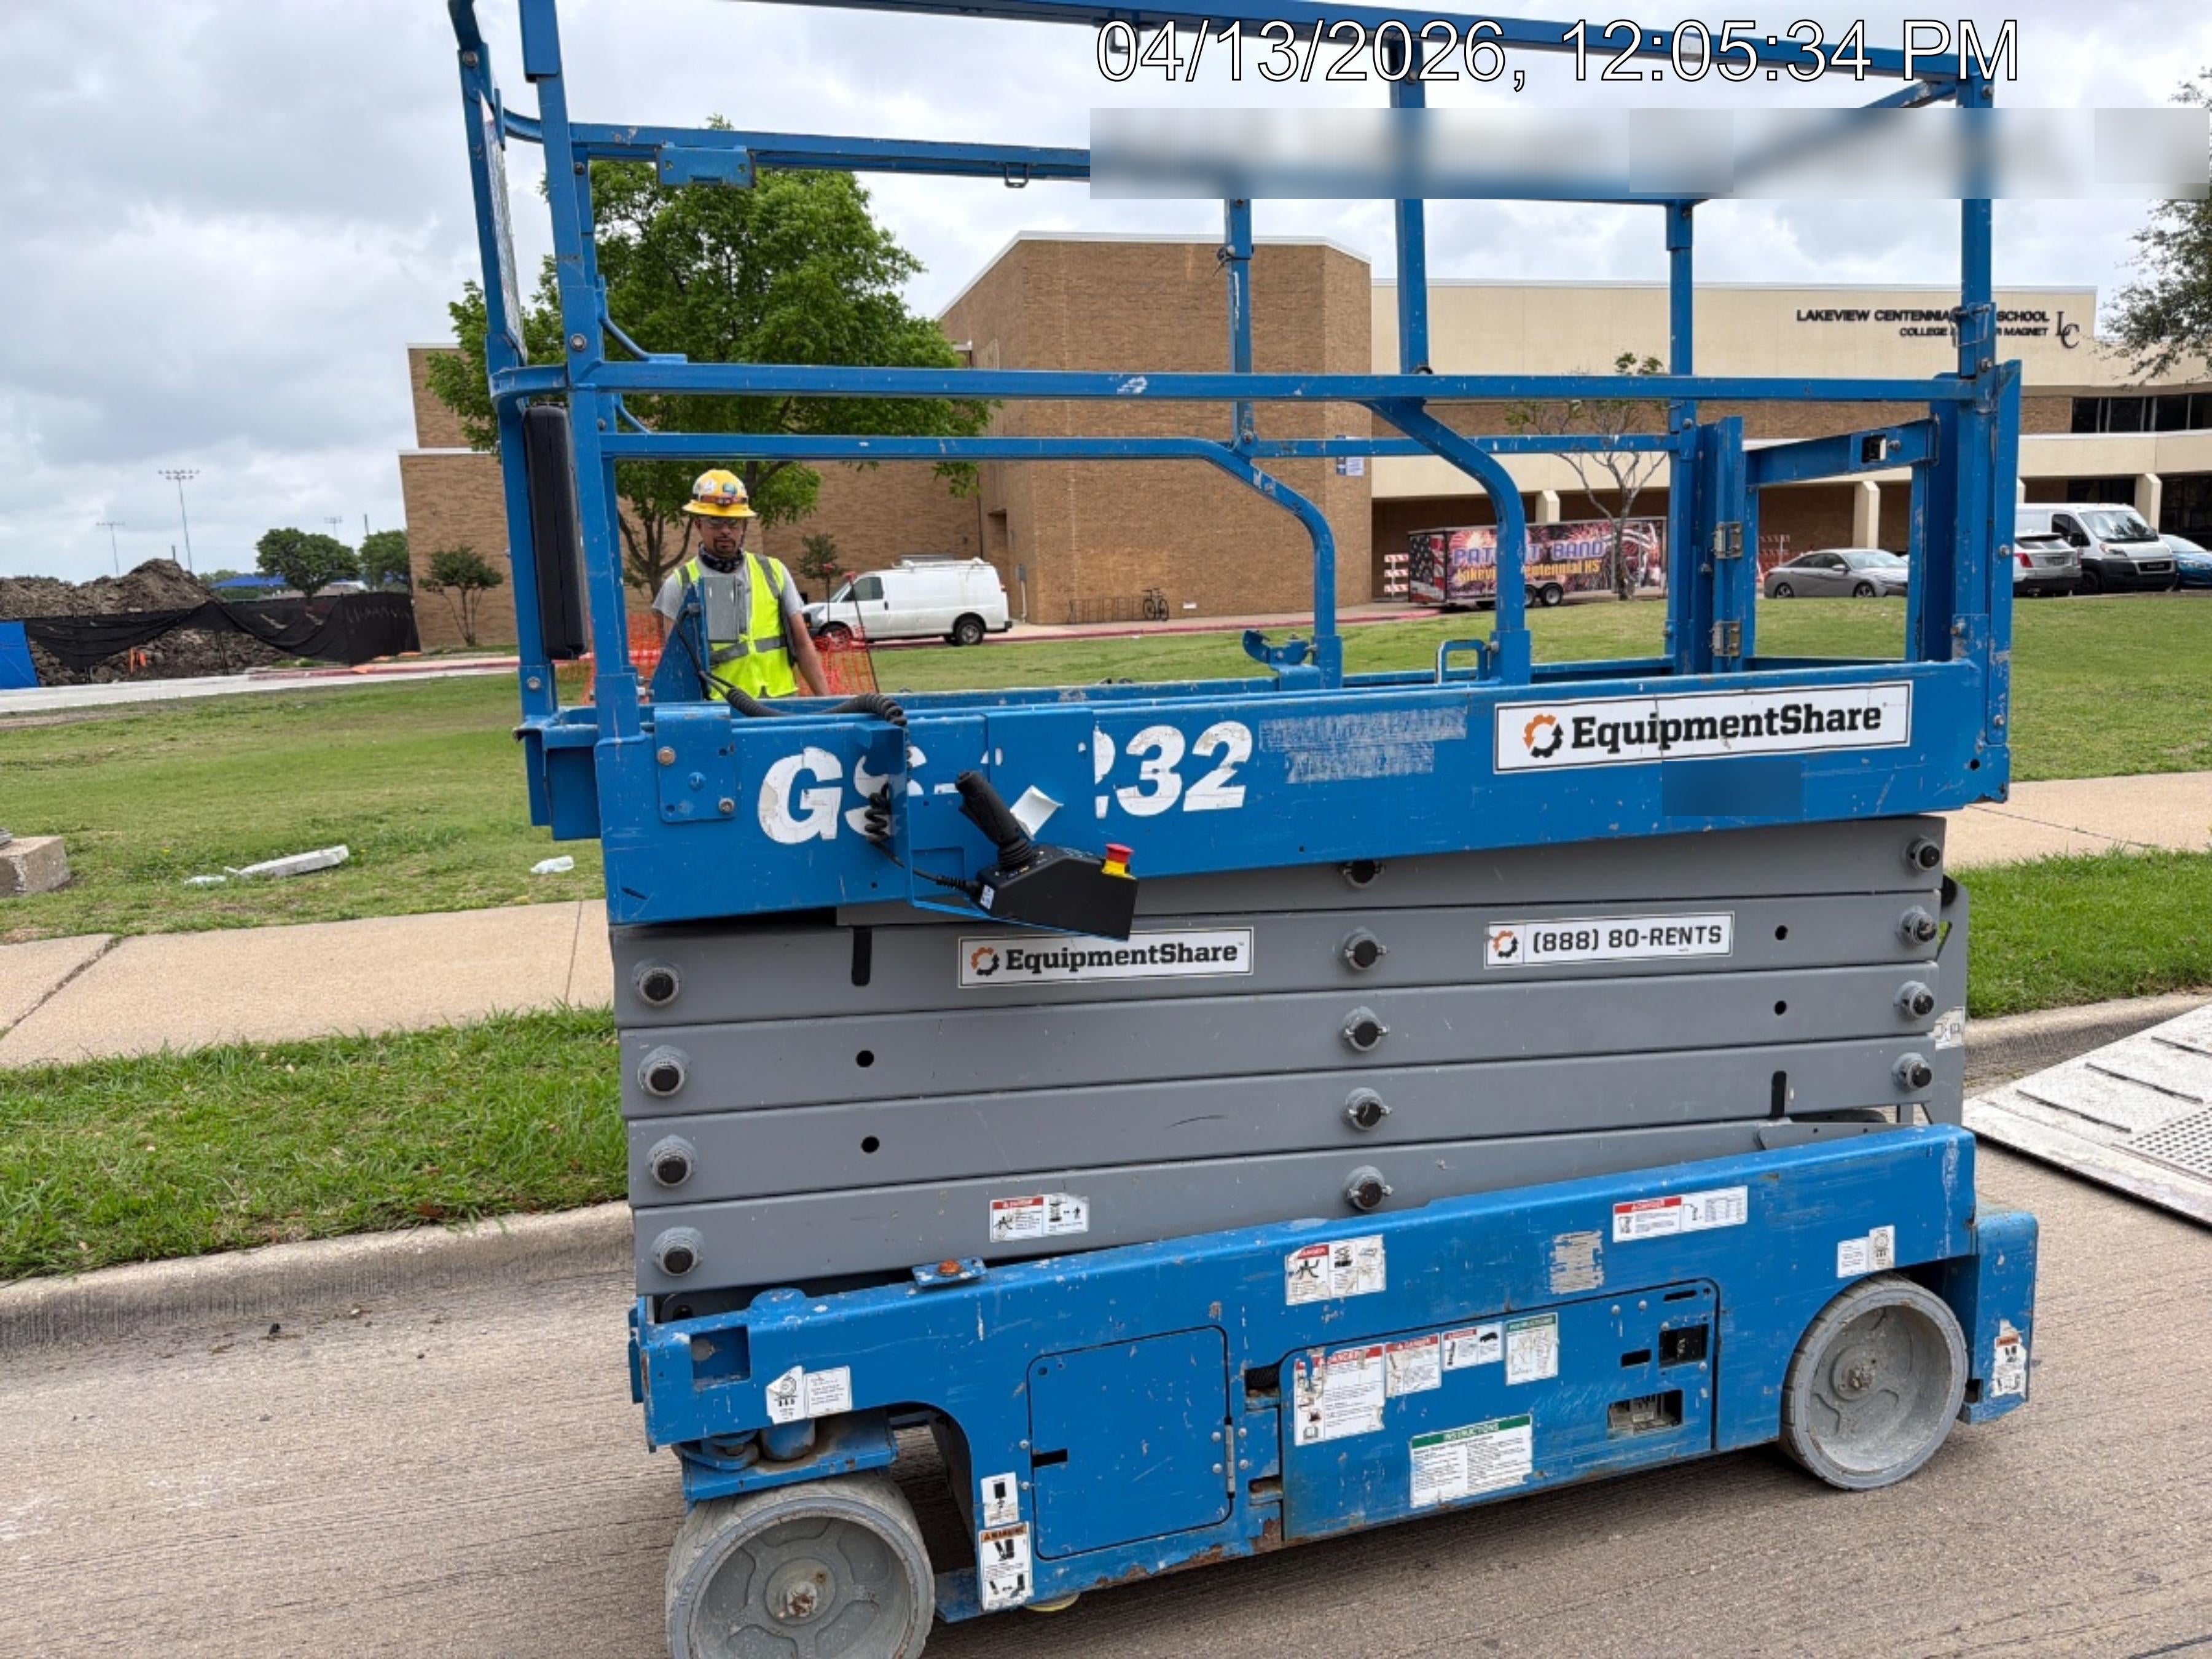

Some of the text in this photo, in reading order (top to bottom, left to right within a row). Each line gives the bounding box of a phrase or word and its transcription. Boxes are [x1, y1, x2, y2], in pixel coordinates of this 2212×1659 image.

[1797, 310, 2050, 322] LAKEVIEW CENTENNIA SCHOOL
[1900, 327, 1947, 336] COLLEGE
[2004, 327, 2049, 336] MAGNET
[1454, 541, 1603, 565] PATT BAND
[1571, 704, 1882, 752] EquipmentShare
[1533, 925, 1722, 953] (888) 80-RENTS
[1005, 943, 1238, 974] EquipmentShare
